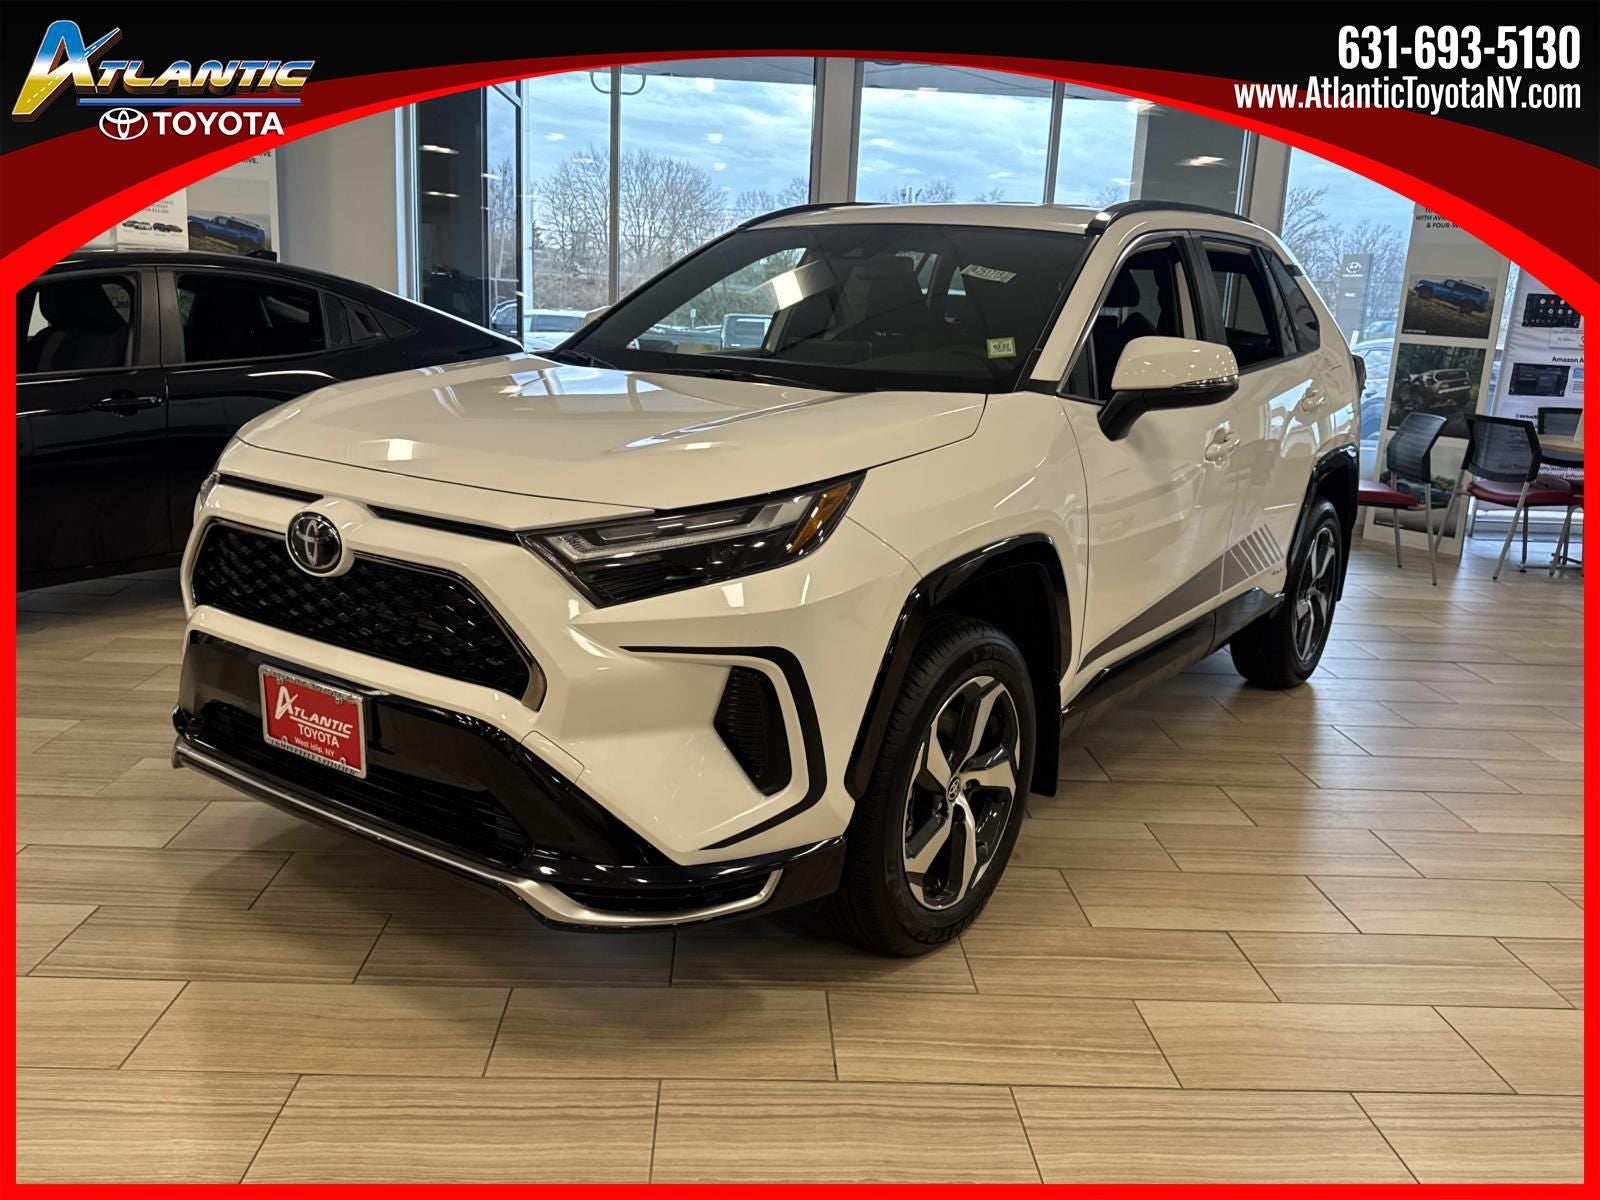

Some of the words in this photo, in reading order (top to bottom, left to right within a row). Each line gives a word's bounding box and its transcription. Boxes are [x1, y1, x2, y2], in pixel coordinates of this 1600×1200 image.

[1551, 355, 1579, 364] Amazon
[275, 685, 354, 735] ATLANTIC
[294, 736, 310, 749] West
[325, 747, 335, 758] NY
[297, 723, 340, 748] TOYOTA
